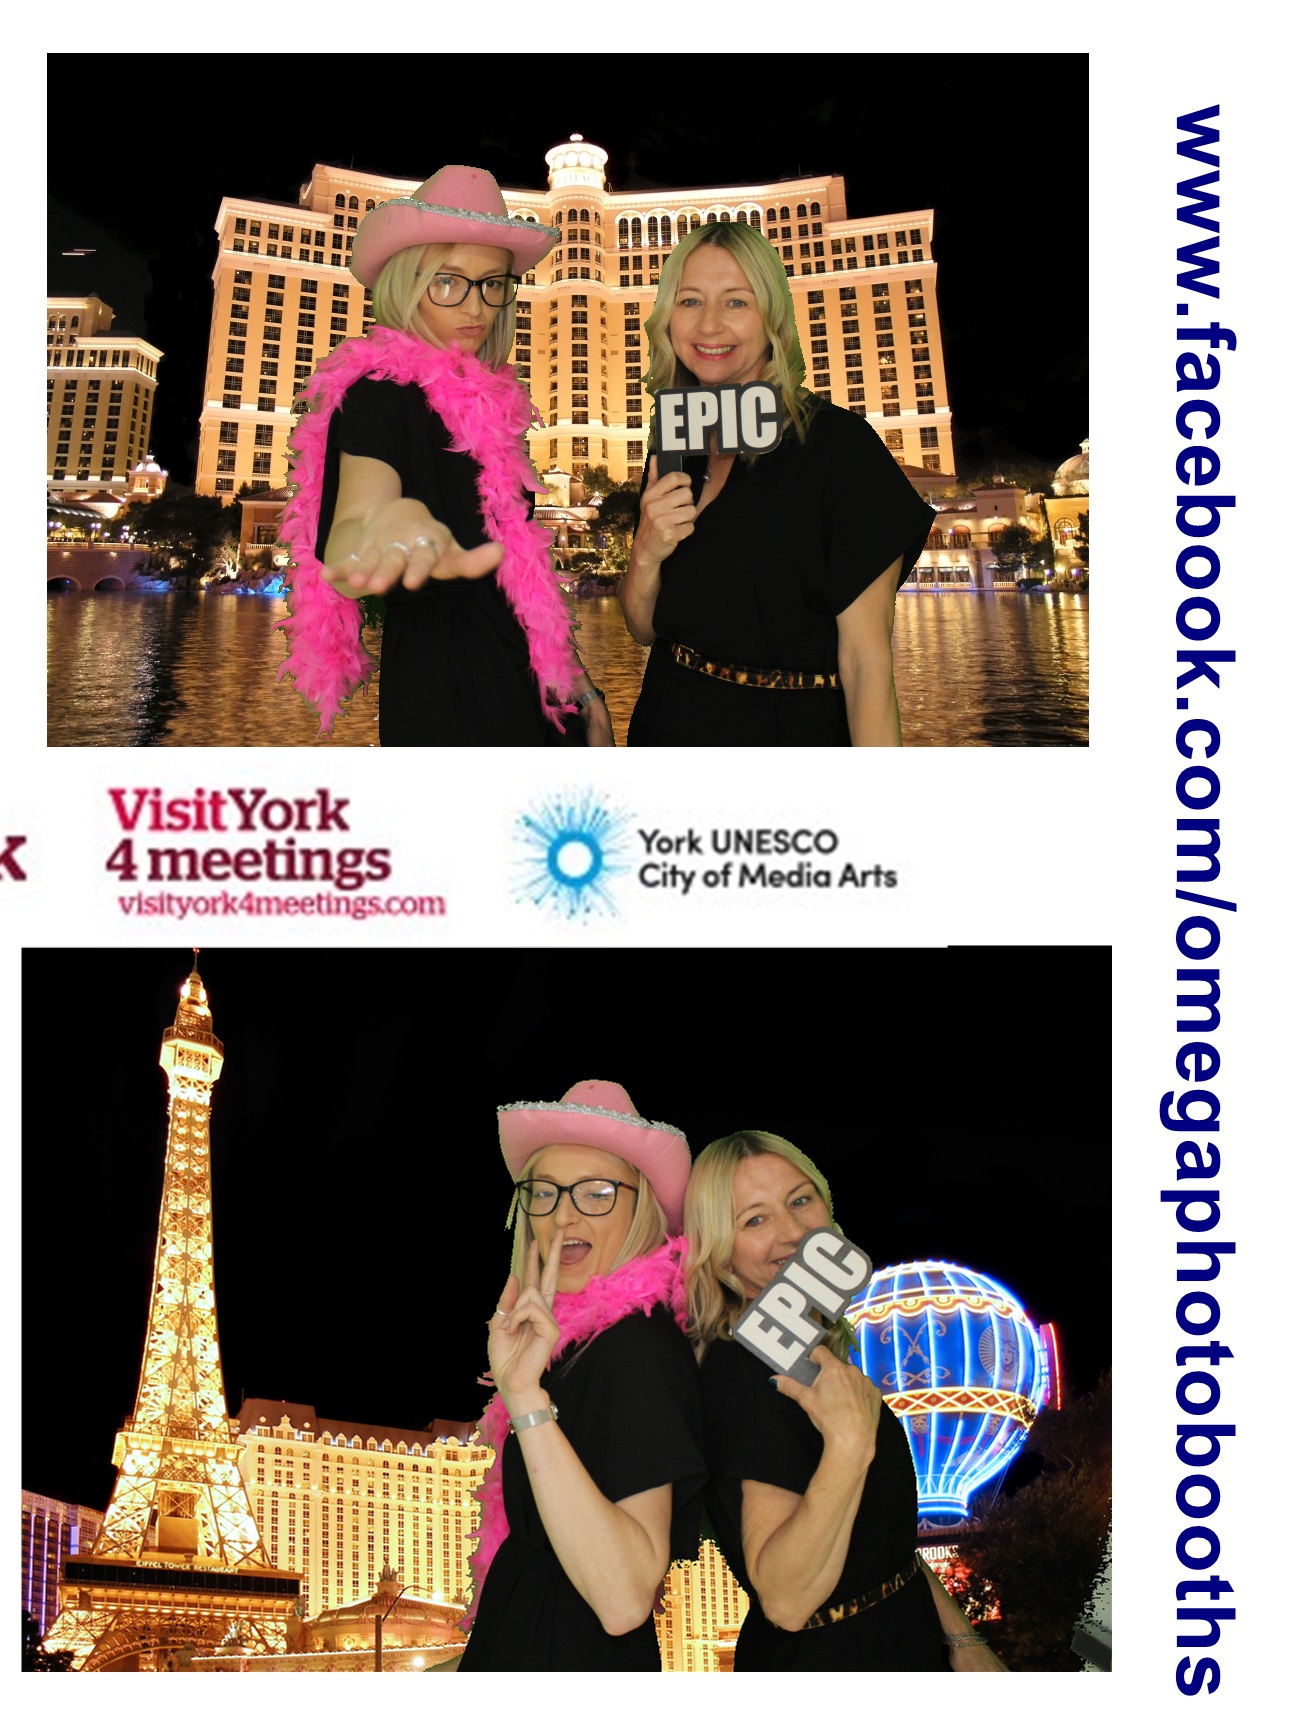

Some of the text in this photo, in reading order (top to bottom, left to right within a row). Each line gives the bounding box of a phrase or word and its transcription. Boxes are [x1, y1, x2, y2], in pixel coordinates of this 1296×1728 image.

[660, 385, 778, 452] EPIC
[736, 1231, 869, 1372] EPIC
[135, 1560, 239, 1574] EIFFEL TOWER RESTAURANT
